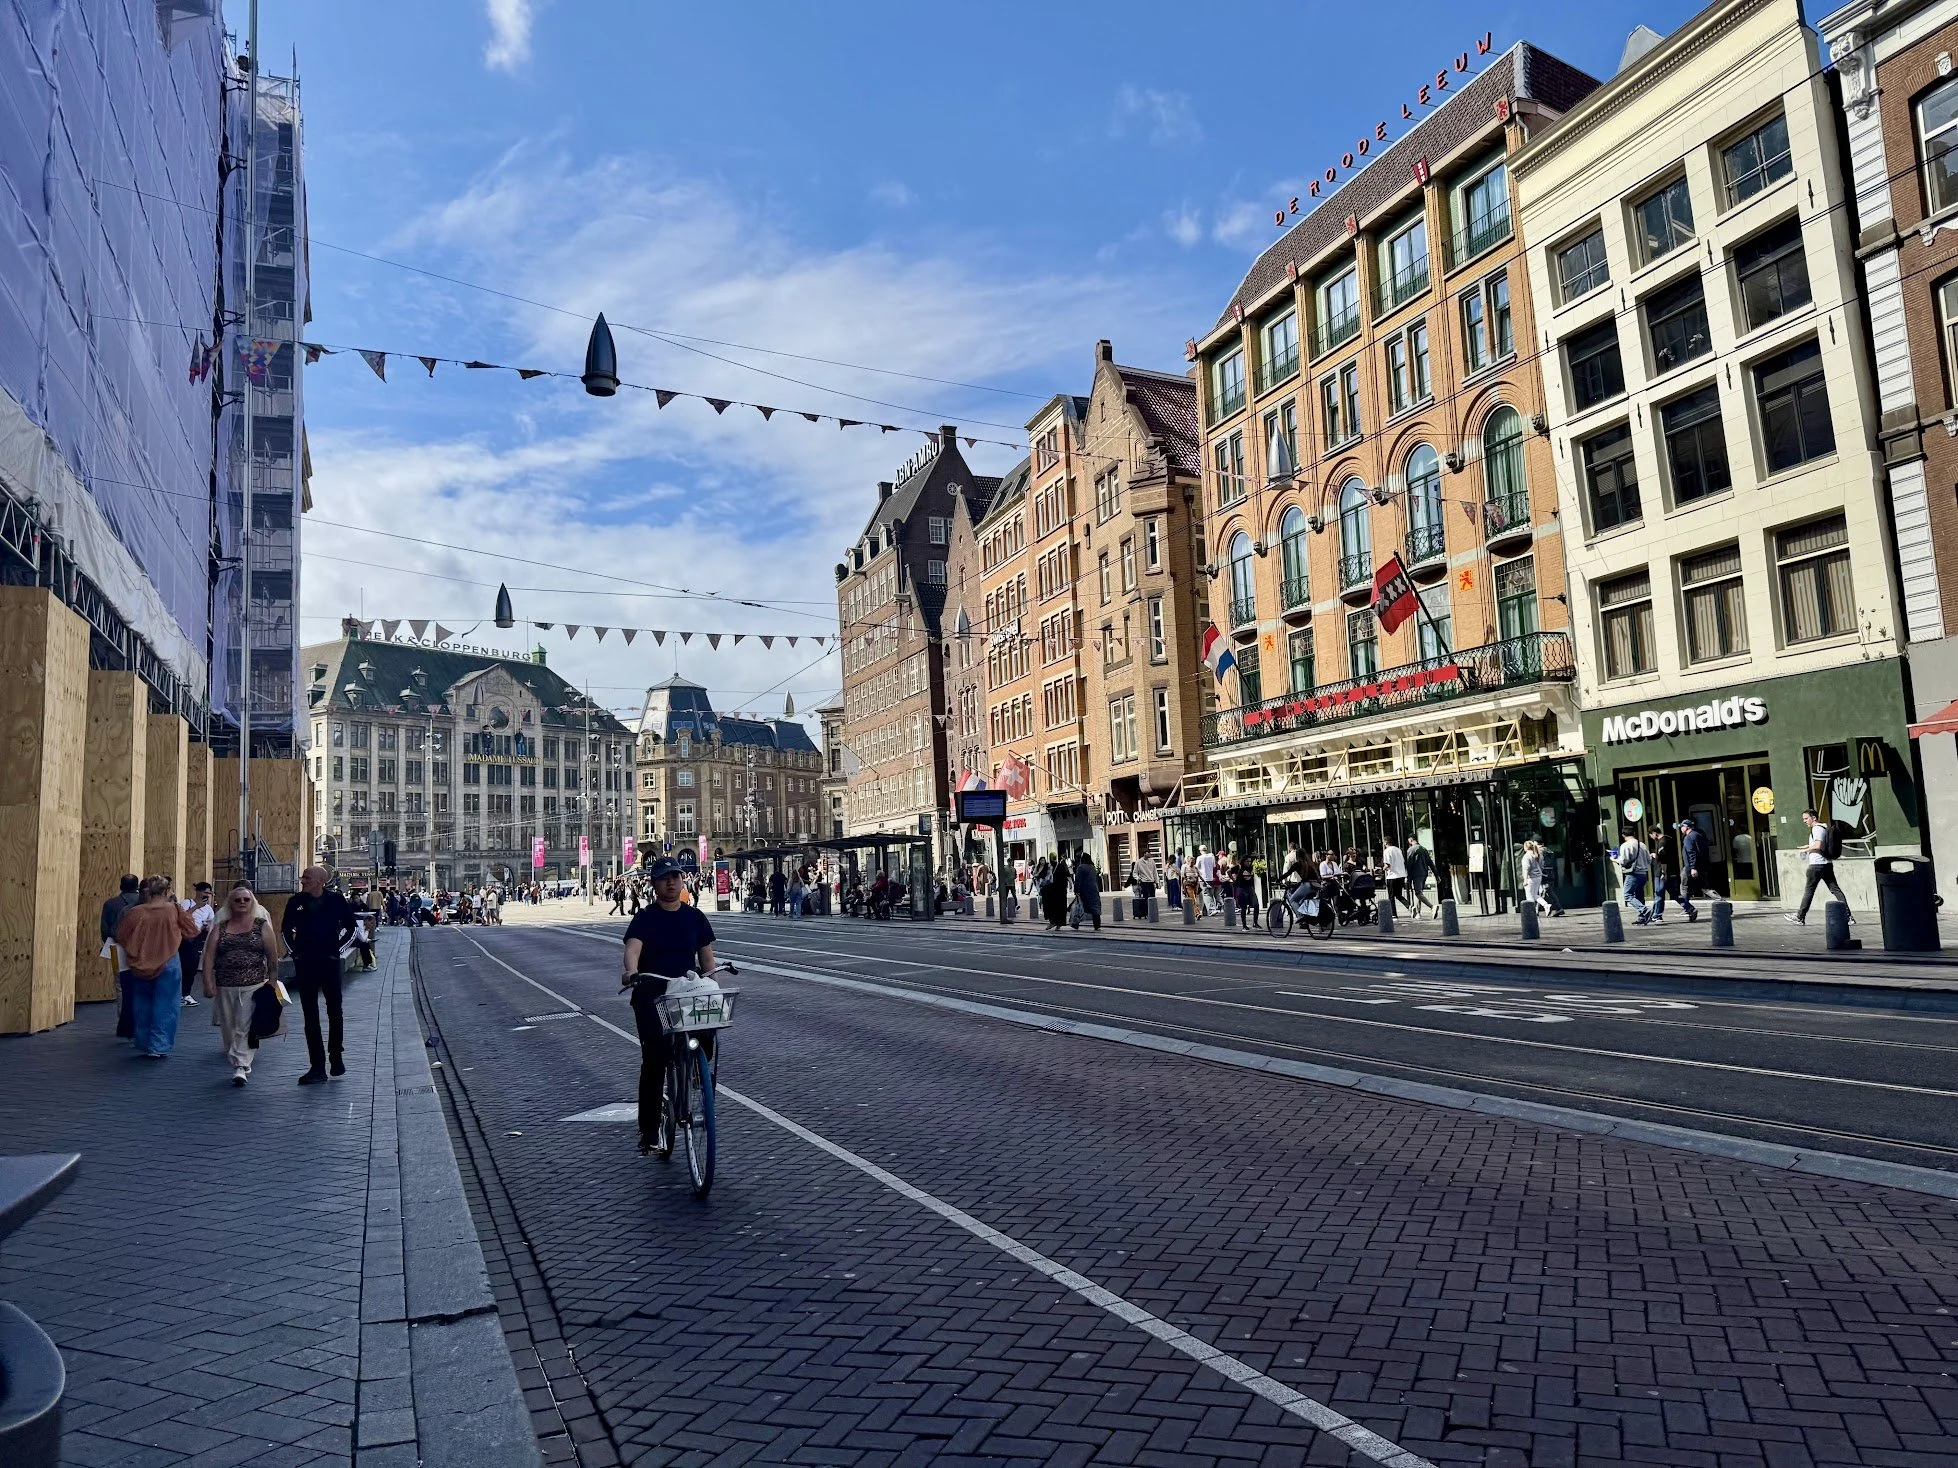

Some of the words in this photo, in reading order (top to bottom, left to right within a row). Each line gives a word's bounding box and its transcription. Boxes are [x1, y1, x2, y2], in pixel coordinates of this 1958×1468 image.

[1275, 197, 1299, 226] DE
[1309, 121, 1387, 196] ROODE
[1401, 31, 1491, 119] LEEUW
[421, 639, 531, 661] CLOPPENBURG
[1602, 695, 1766, 743] McDonald's
[467, 752, 506, 764] MADAME
[1106, 810, 1125, 825] POTT
[1411, 994, 1699, 1023] BUS
